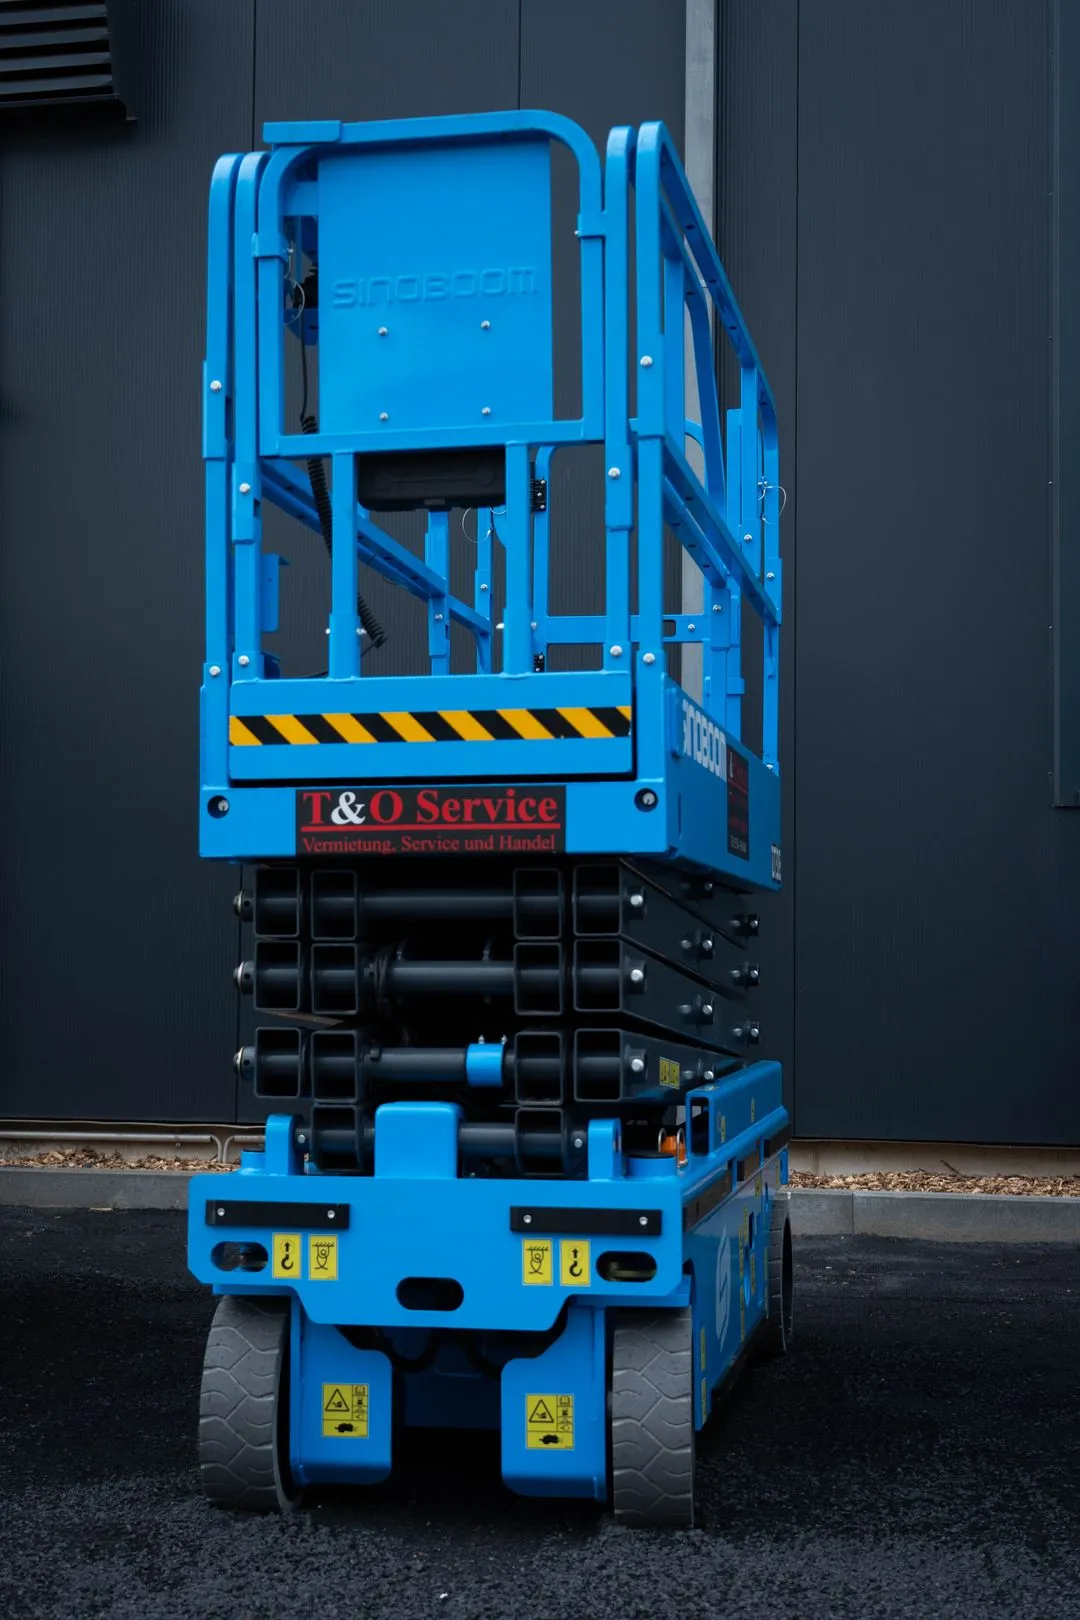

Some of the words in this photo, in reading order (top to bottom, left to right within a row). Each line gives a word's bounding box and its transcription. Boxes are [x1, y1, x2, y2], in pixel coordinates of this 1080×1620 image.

[333, 267, 538, 308] SINOBOOM
[303, 790, 404, 825] T&O
[416, 788, 557, 823] Service
[401, 836, 461, 852] Service
[464, 836, 494, 850] und
[499, 834, 555, 850] Handel
